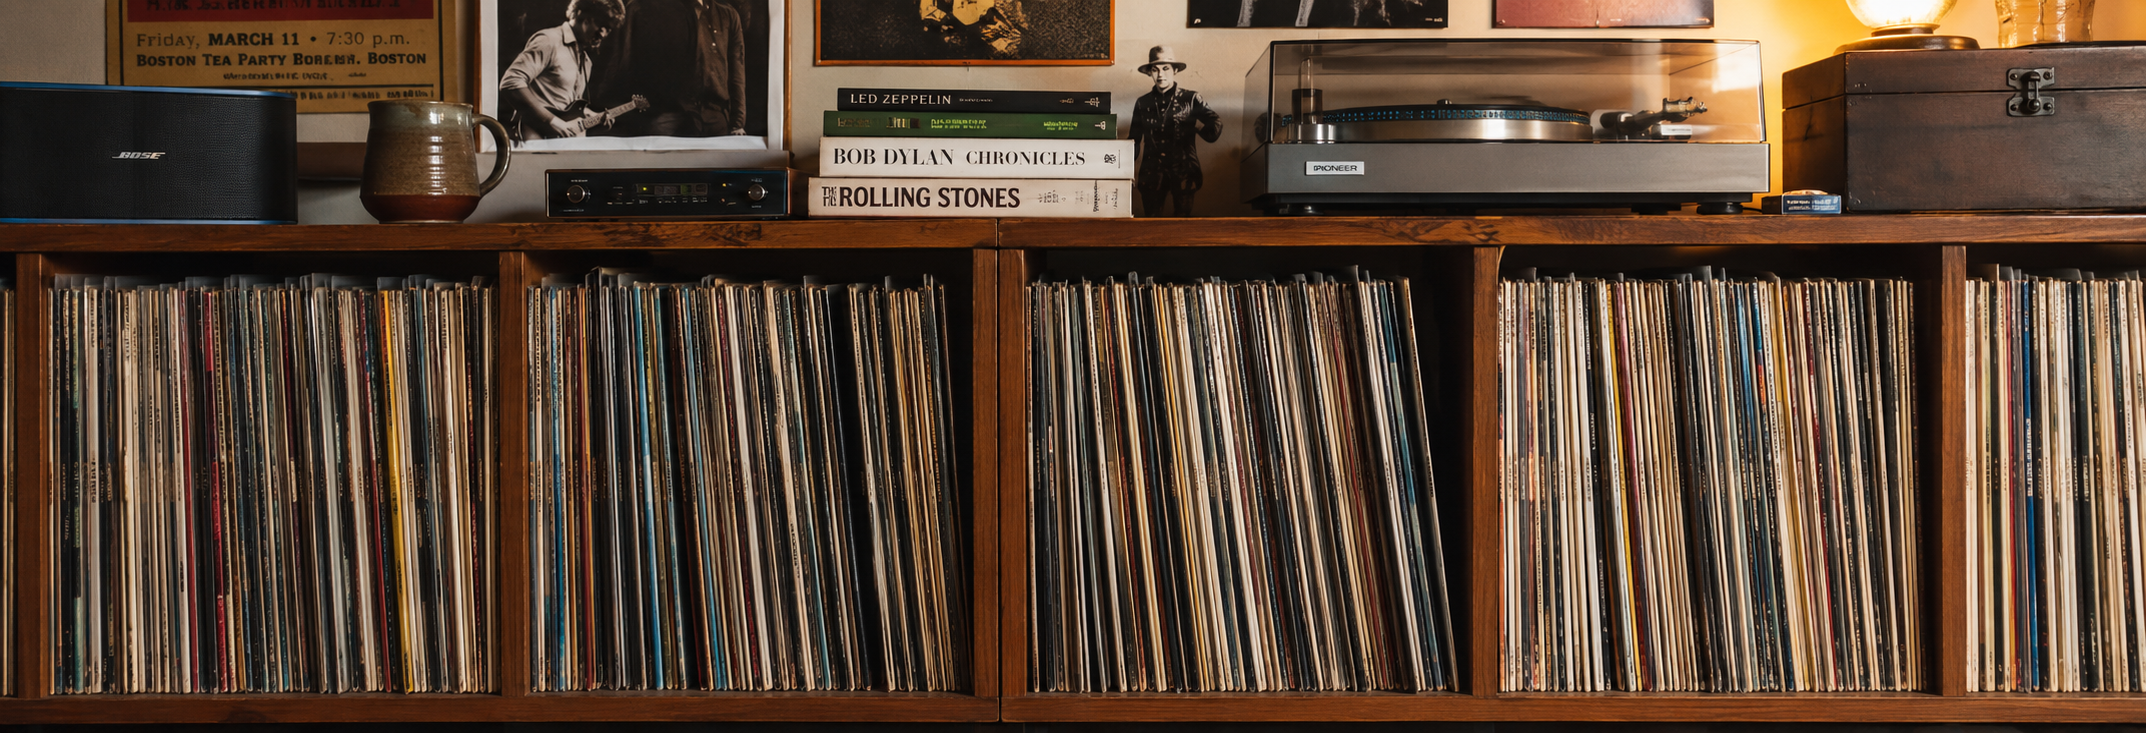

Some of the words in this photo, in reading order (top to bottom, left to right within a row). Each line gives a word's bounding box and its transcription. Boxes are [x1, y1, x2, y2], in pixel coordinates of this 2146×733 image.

[208, 32, 274, 46] MARCH
[282, 32, 300, 46] 11
[326, 31, 365, 45] 7:30
[372, 33, 410, 48] p.m.
[136, 54, 196, 67] BOSTON
[202, 53, 232, 66] TEA
[238, 53, 287, 66] PARTY
[367, 52, 426, 65] BOSTON
[850, 93, 878, 104] LED
[882, 94, 951, 105] ZEPPELIN
[112, 151, 166, 160] BOSE
[833, 148, 876, 165] BOB
[884, 148, 954, 165] DYLAN
[966, 150, 1086, 166] CHRONICLES
[839, 186, 931, 208] ROLLING
[938, 186, 1020, 209] STONES
